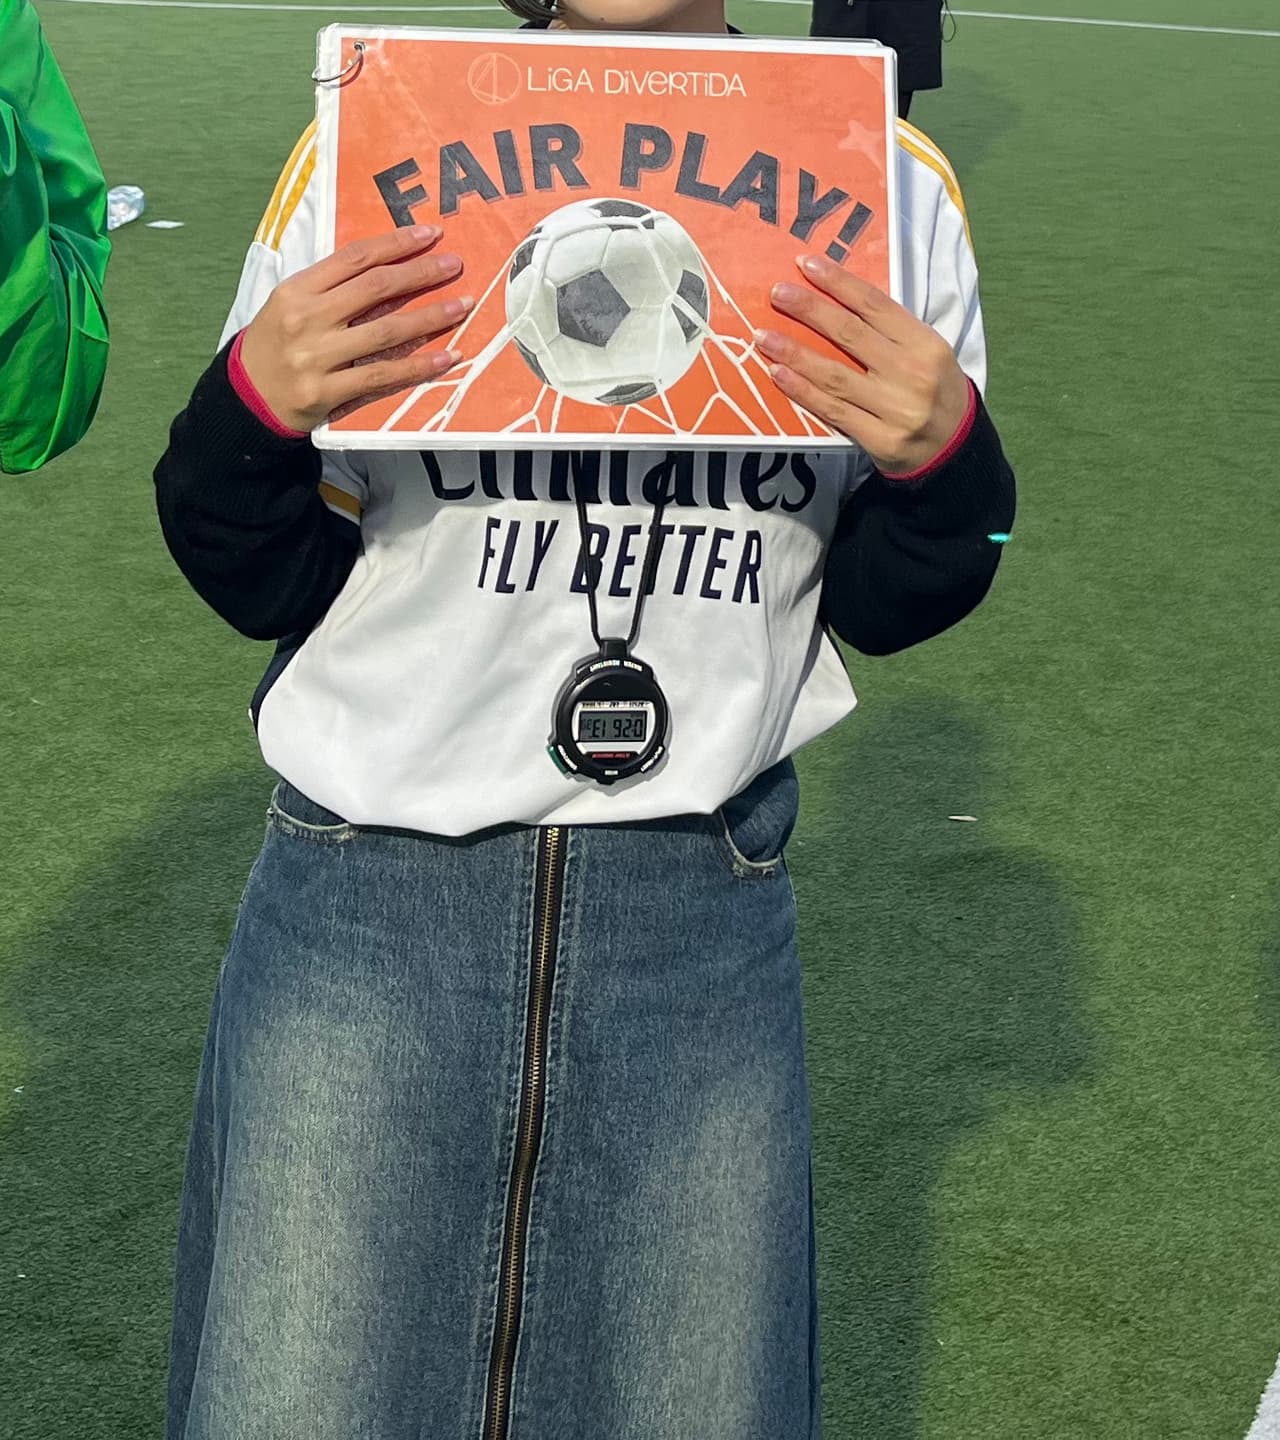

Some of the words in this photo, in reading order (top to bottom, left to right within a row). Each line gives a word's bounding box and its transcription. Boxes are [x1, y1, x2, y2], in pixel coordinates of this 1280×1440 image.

[373, 122, 590, 229] FAIR
[620, 122, 874, 264] PLAY!
[478, 516, 560, 594] FLY
[569, 521, 763, 604] BETTER
